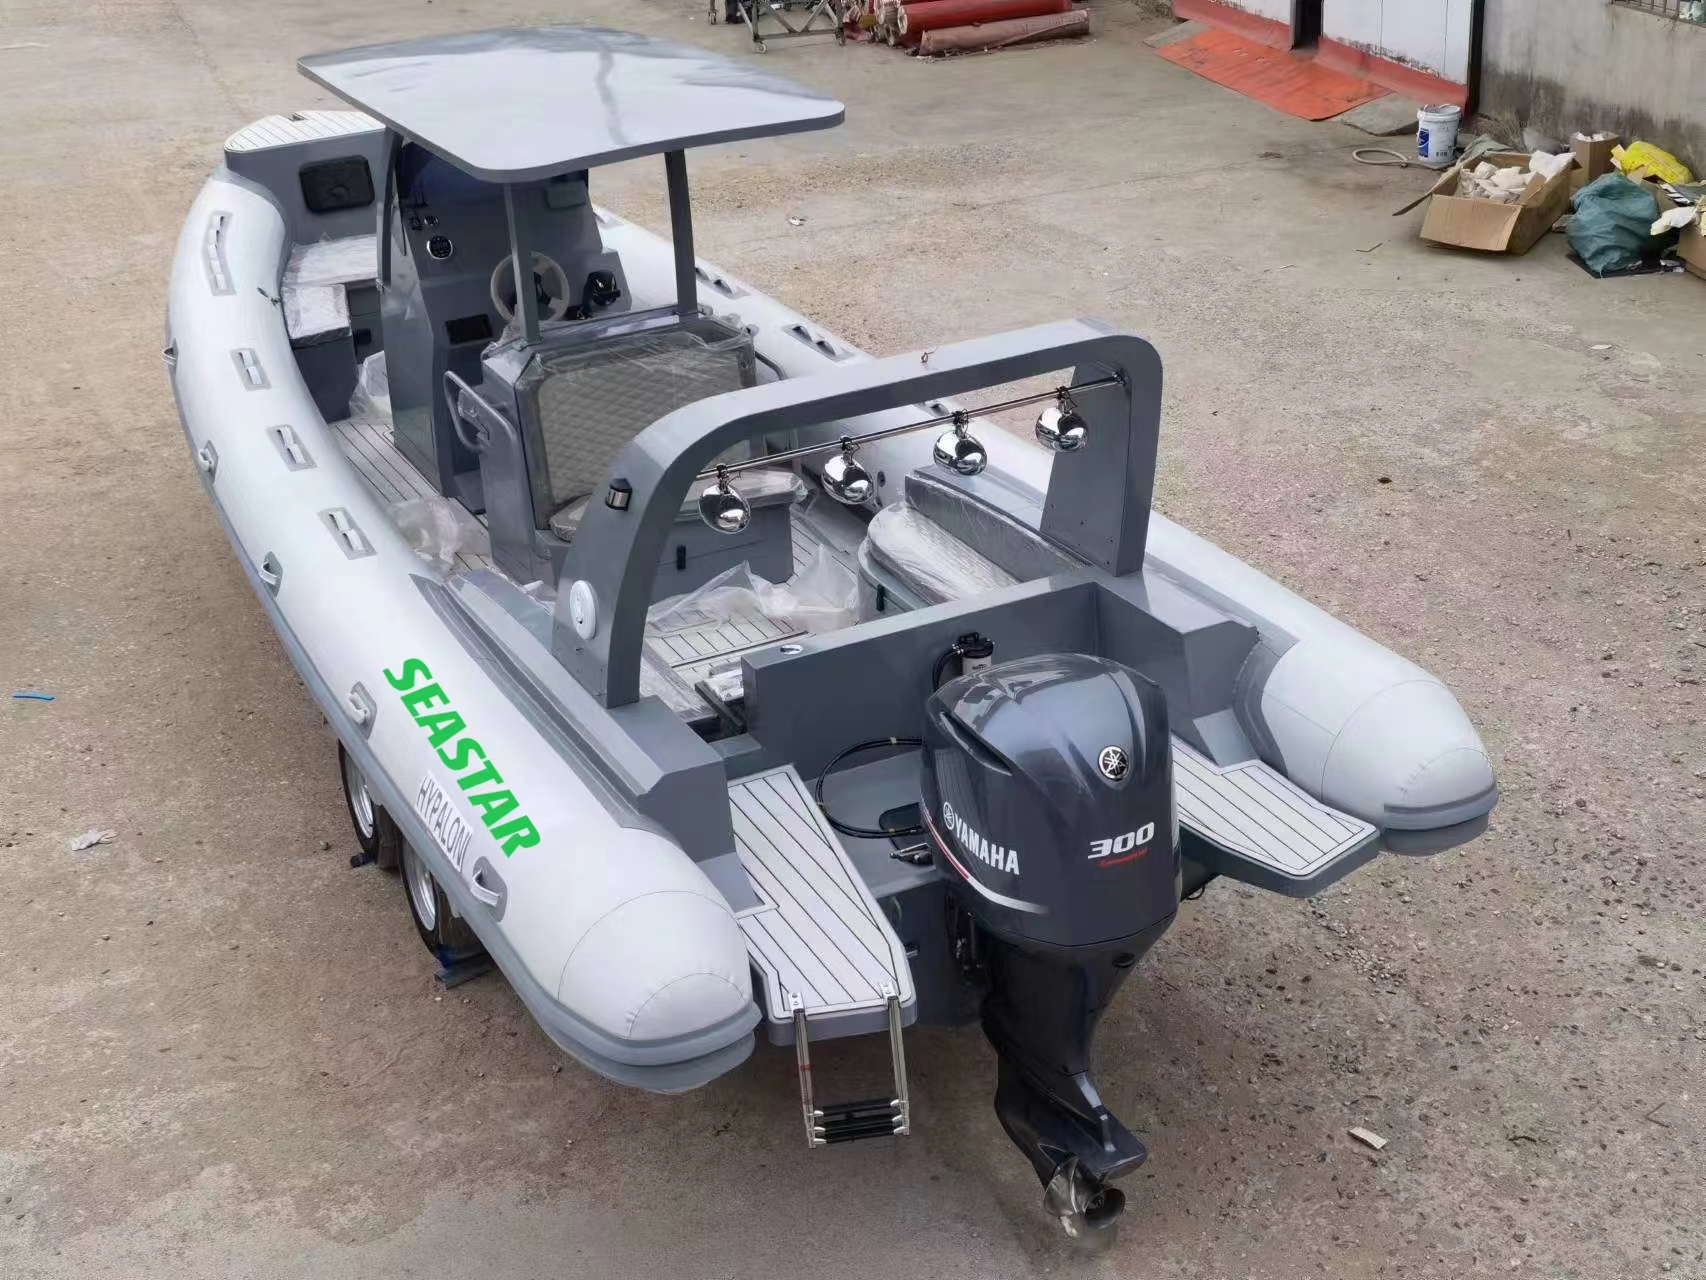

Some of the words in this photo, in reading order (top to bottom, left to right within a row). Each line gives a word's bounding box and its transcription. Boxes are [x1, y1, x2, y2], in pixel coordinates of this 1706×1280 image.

[382, 658, 541, 859] SEASTAR
[416, 776, 473, 873] HYPALON
[954, 814, 1020, 875] YAMAHA
[1087, 821, 1155, 860] 300
